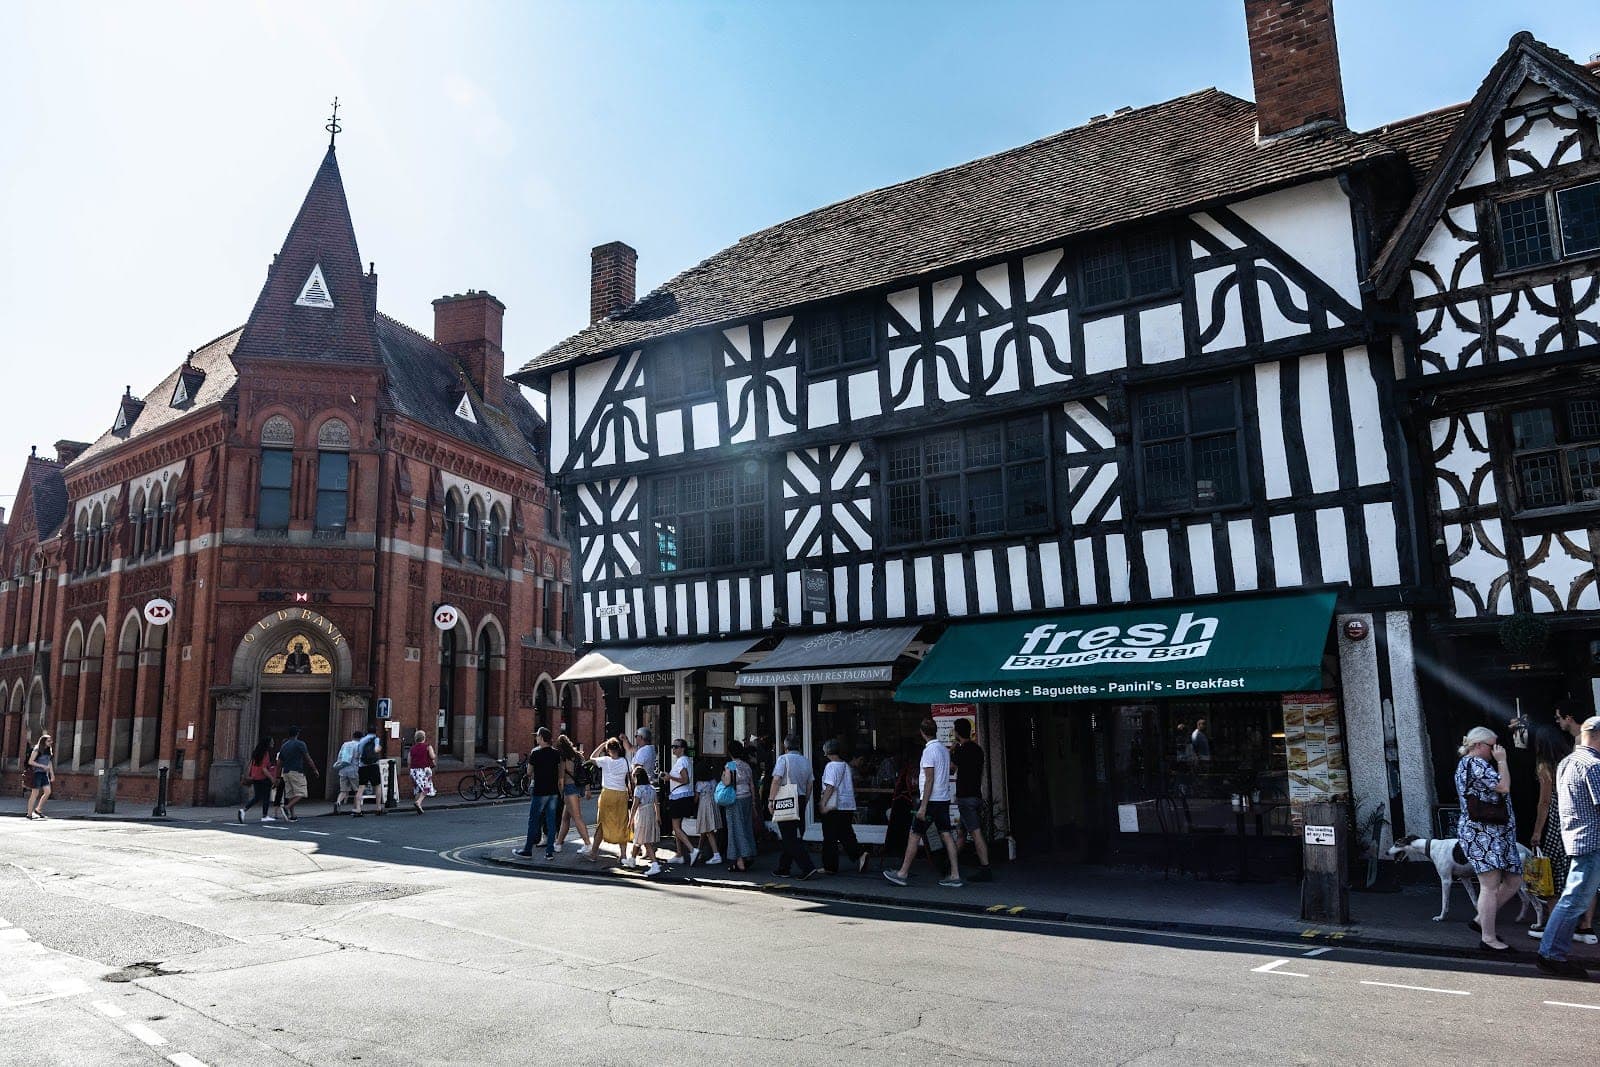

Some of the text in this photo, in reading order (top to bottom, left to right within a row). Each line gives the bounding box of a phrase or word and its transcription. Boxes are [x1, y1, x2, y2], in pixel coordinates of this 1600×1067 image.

[599, 606, 616, 615] HIGH
[244, 609, 346, 645] OLD BANK
[1019, 612, 1220, 654] fresh
[1009, 643, 1203, 669] Baguette Bar
[656, 672, 675, 683] Squi
[742, 668, 886, 684] THAI TAPAS & THAI RESTAURANT
[949, 686, 1021, 700] Sandwiches
[1033, 685, 1097, 698] Baguettes
[1108, 680, 1162, 693] Panini's
[1176, 677, 1245, 690] Breakfast
